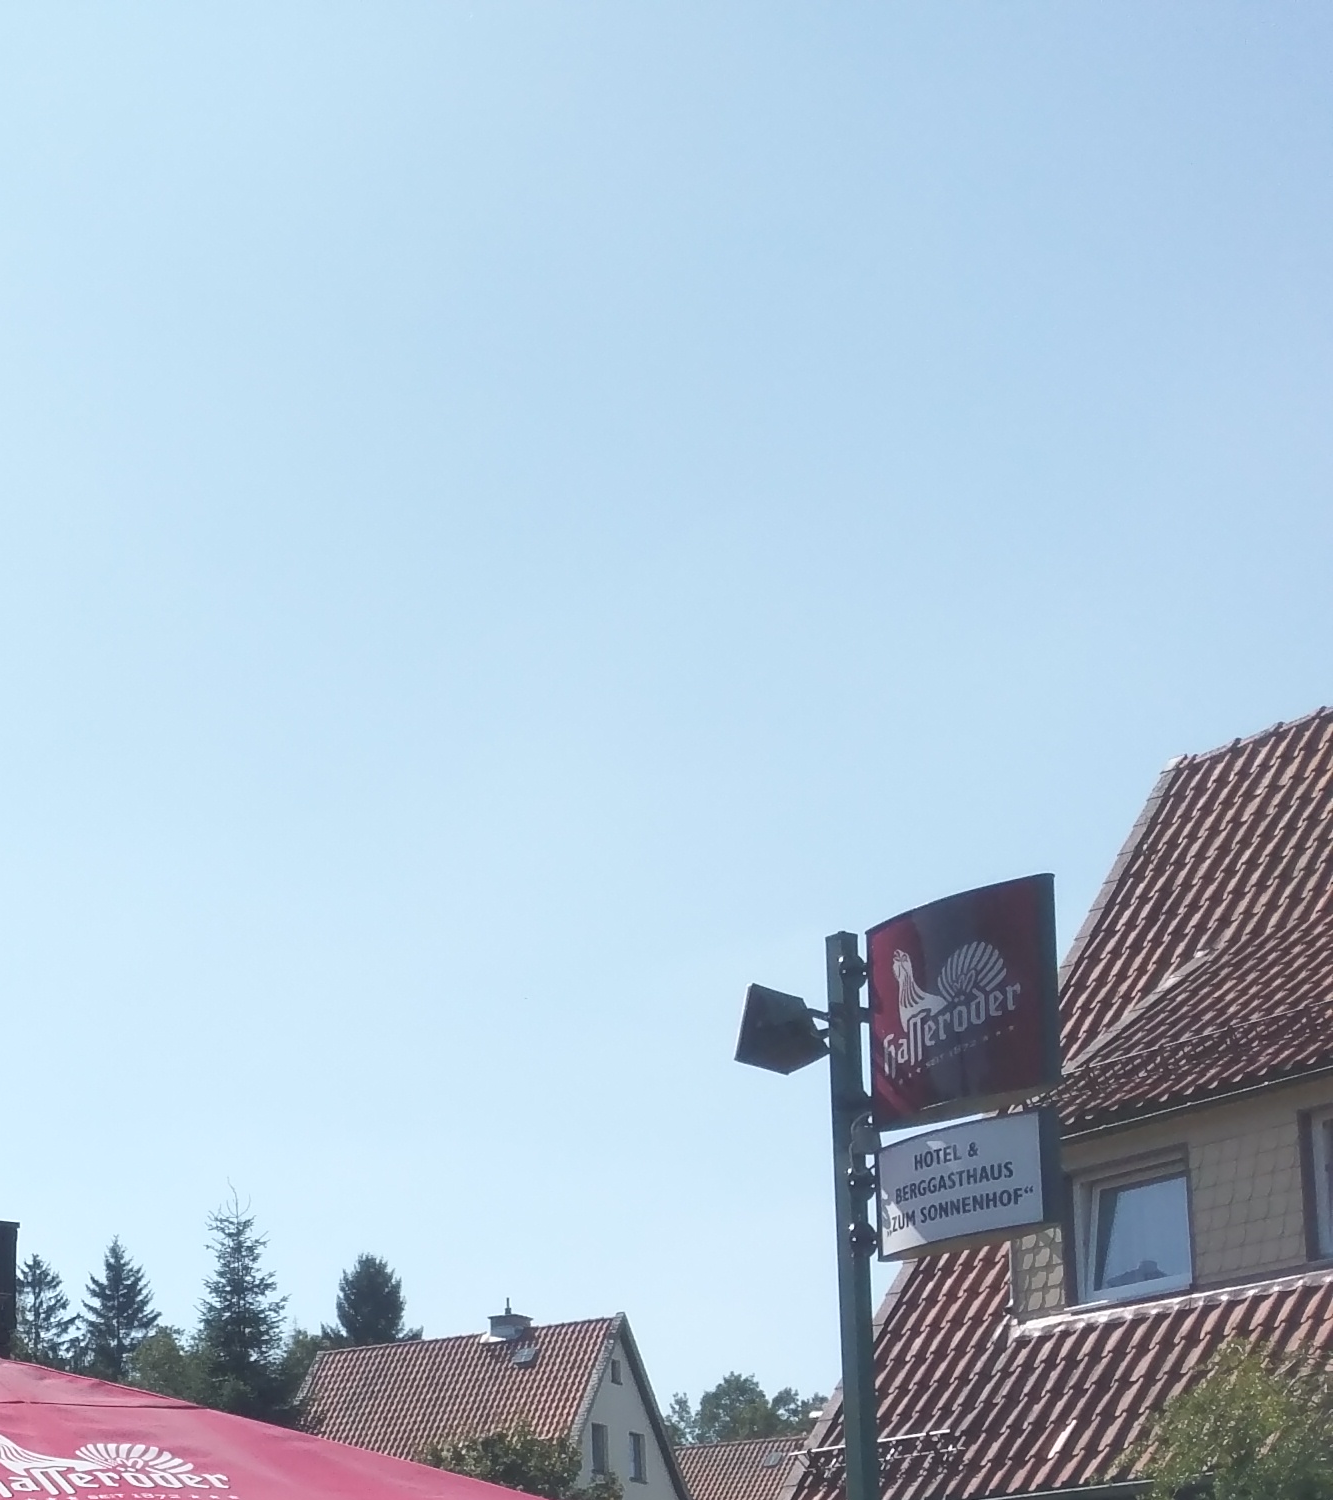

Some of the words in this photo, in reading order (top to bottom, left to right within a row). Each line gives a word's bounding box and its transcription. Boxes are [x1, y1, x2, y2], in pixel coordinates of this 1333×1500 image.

[914, 1144, 962, 1171] HOTEL
[967, 1141, 979, 1158] &
[895, 1161, 1014, 1205] BERGGASTHAUS
